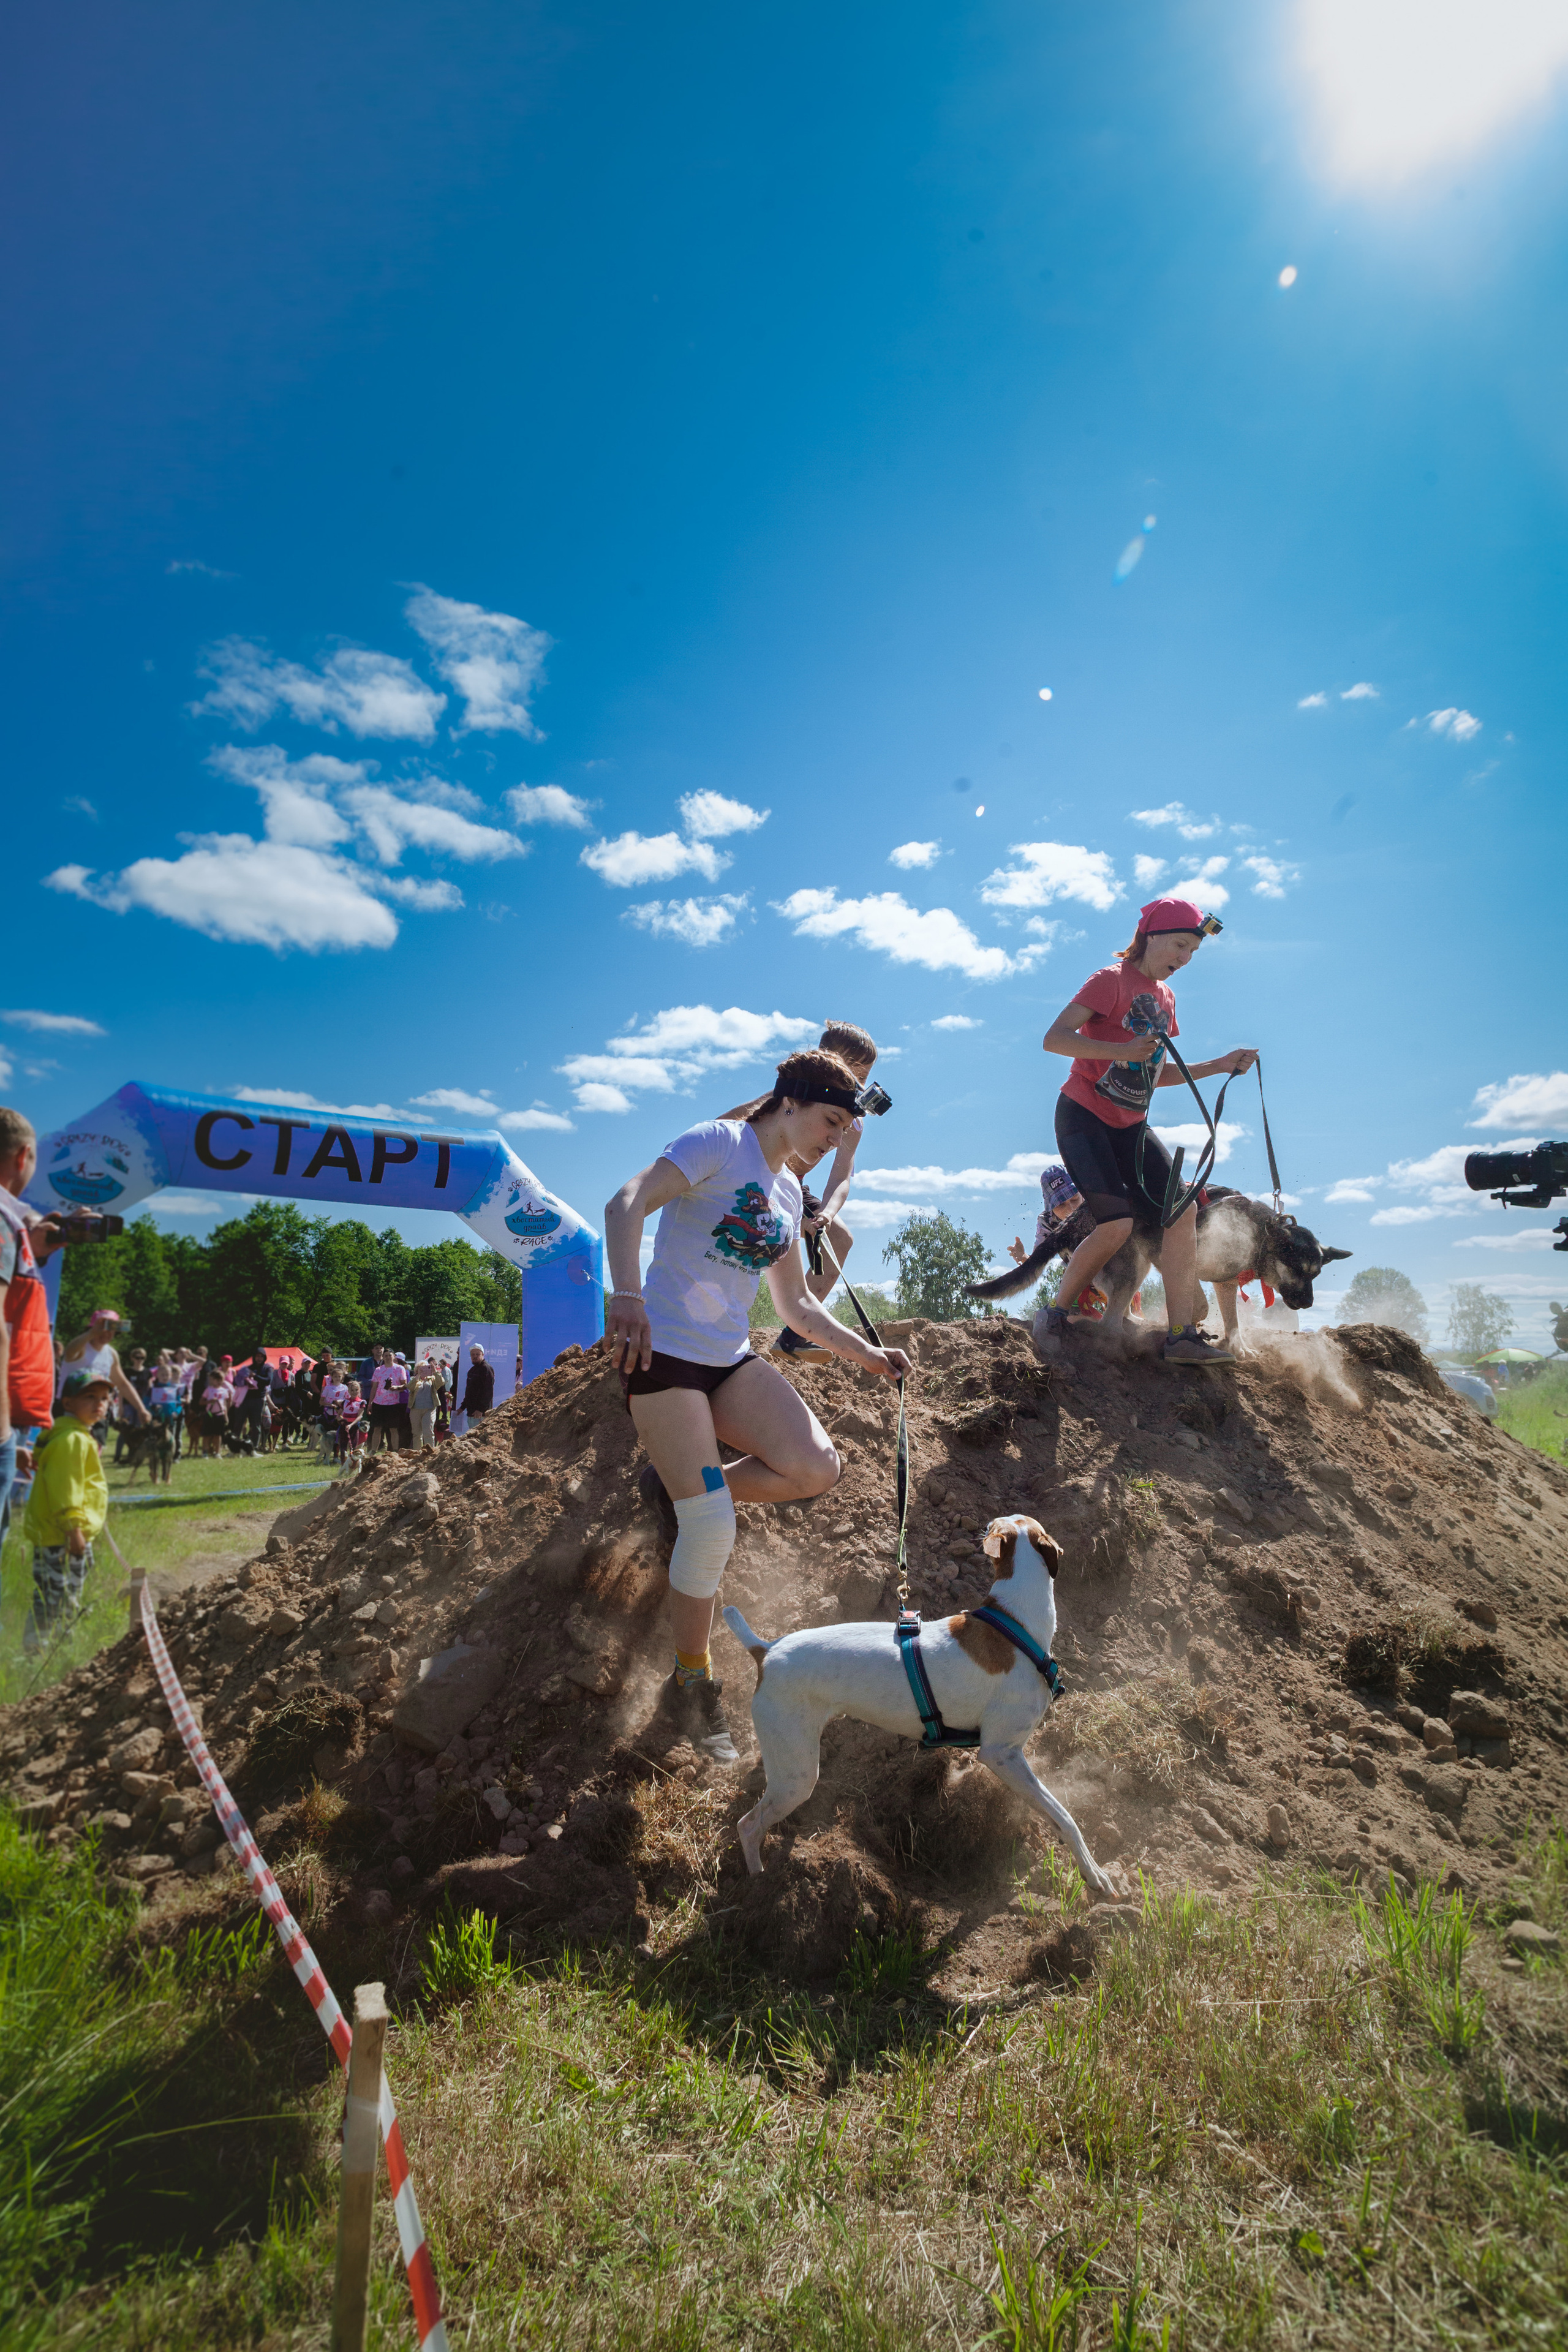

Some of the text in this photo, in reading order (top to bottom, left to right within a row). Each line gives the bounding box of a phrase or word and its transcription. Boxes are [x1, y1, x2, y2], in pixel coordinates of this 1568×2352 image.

[1122, 1085, 1147, 1096] REQUES
[101, 1135, 129, 1152] DOG
[194, 1110, 465, 1189] СТАРТ
[511, 1178, 530, 1189] CRAZY
[1050, 1177, 1063, 1189] UFC
[523, 1223, 547, 1233] драйв
[521, 1236, 548, 1246] RACE
[704, 1250, 718, 1263] Бегу,
[720, 1259, 739, 1271] потому
